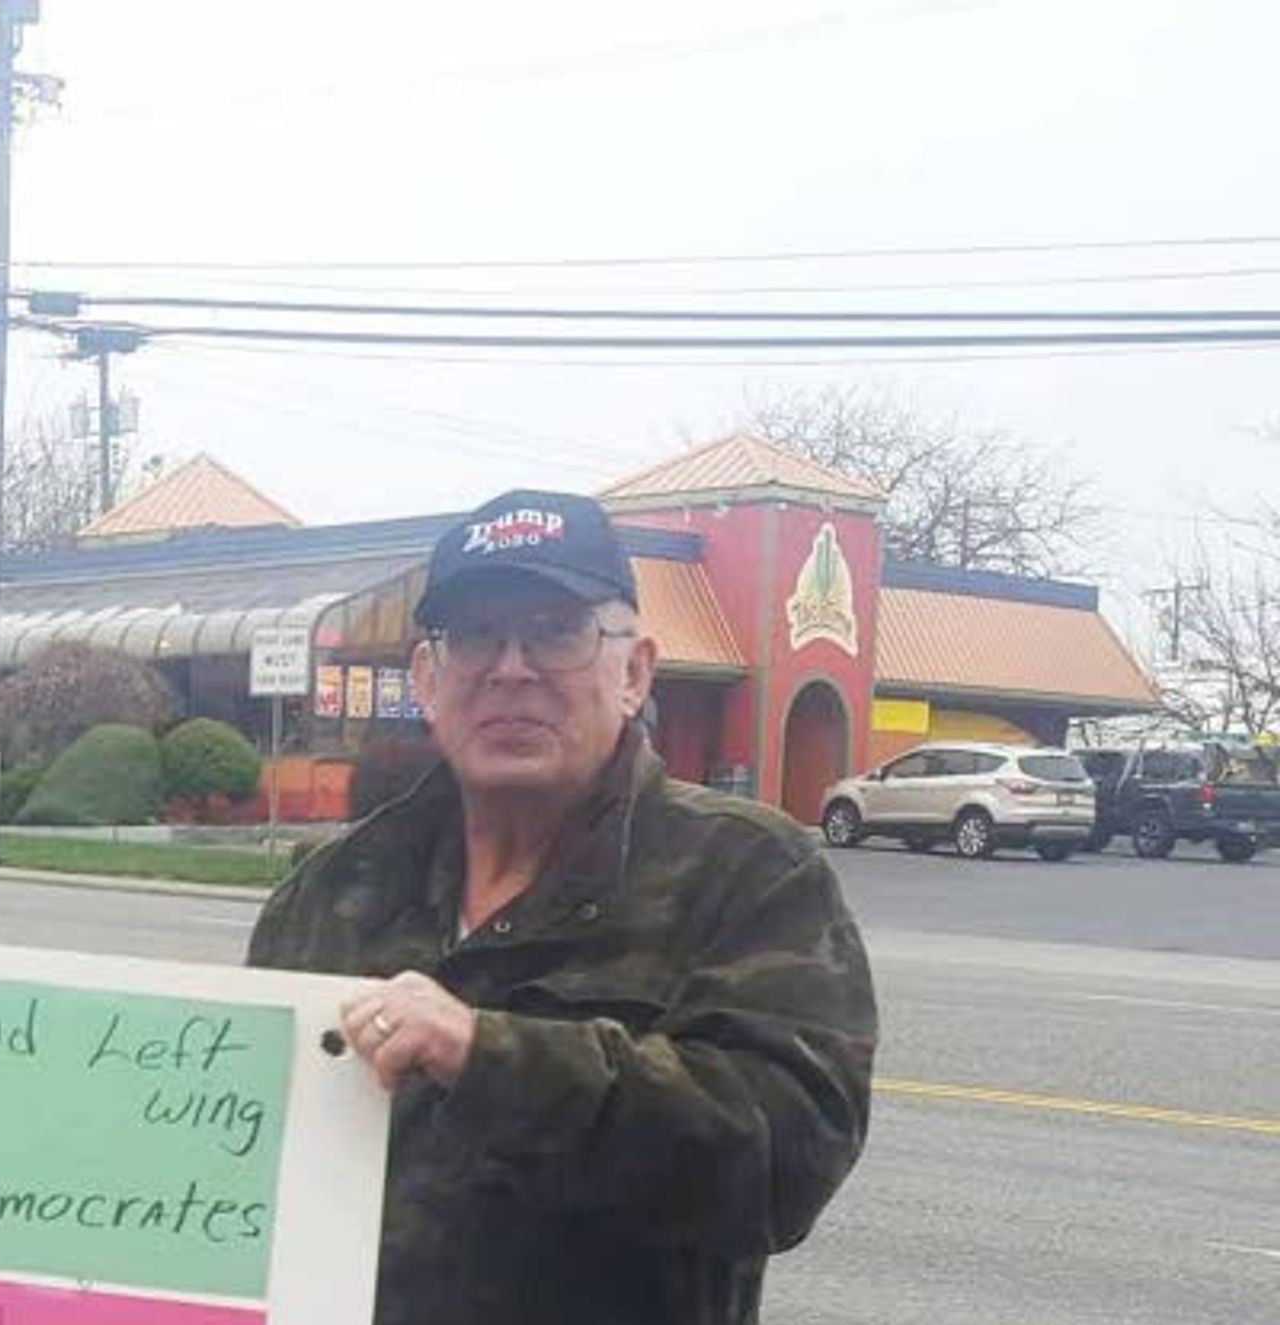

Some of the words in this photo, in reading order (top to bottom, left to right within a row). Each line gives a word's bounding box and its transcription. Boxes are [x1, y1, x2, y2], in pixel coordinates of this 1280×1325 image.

[463, 509, 564, 545] Trump
[88, 1014, 250, 1070] Left
[143, 1088, 264, 1157] wing
